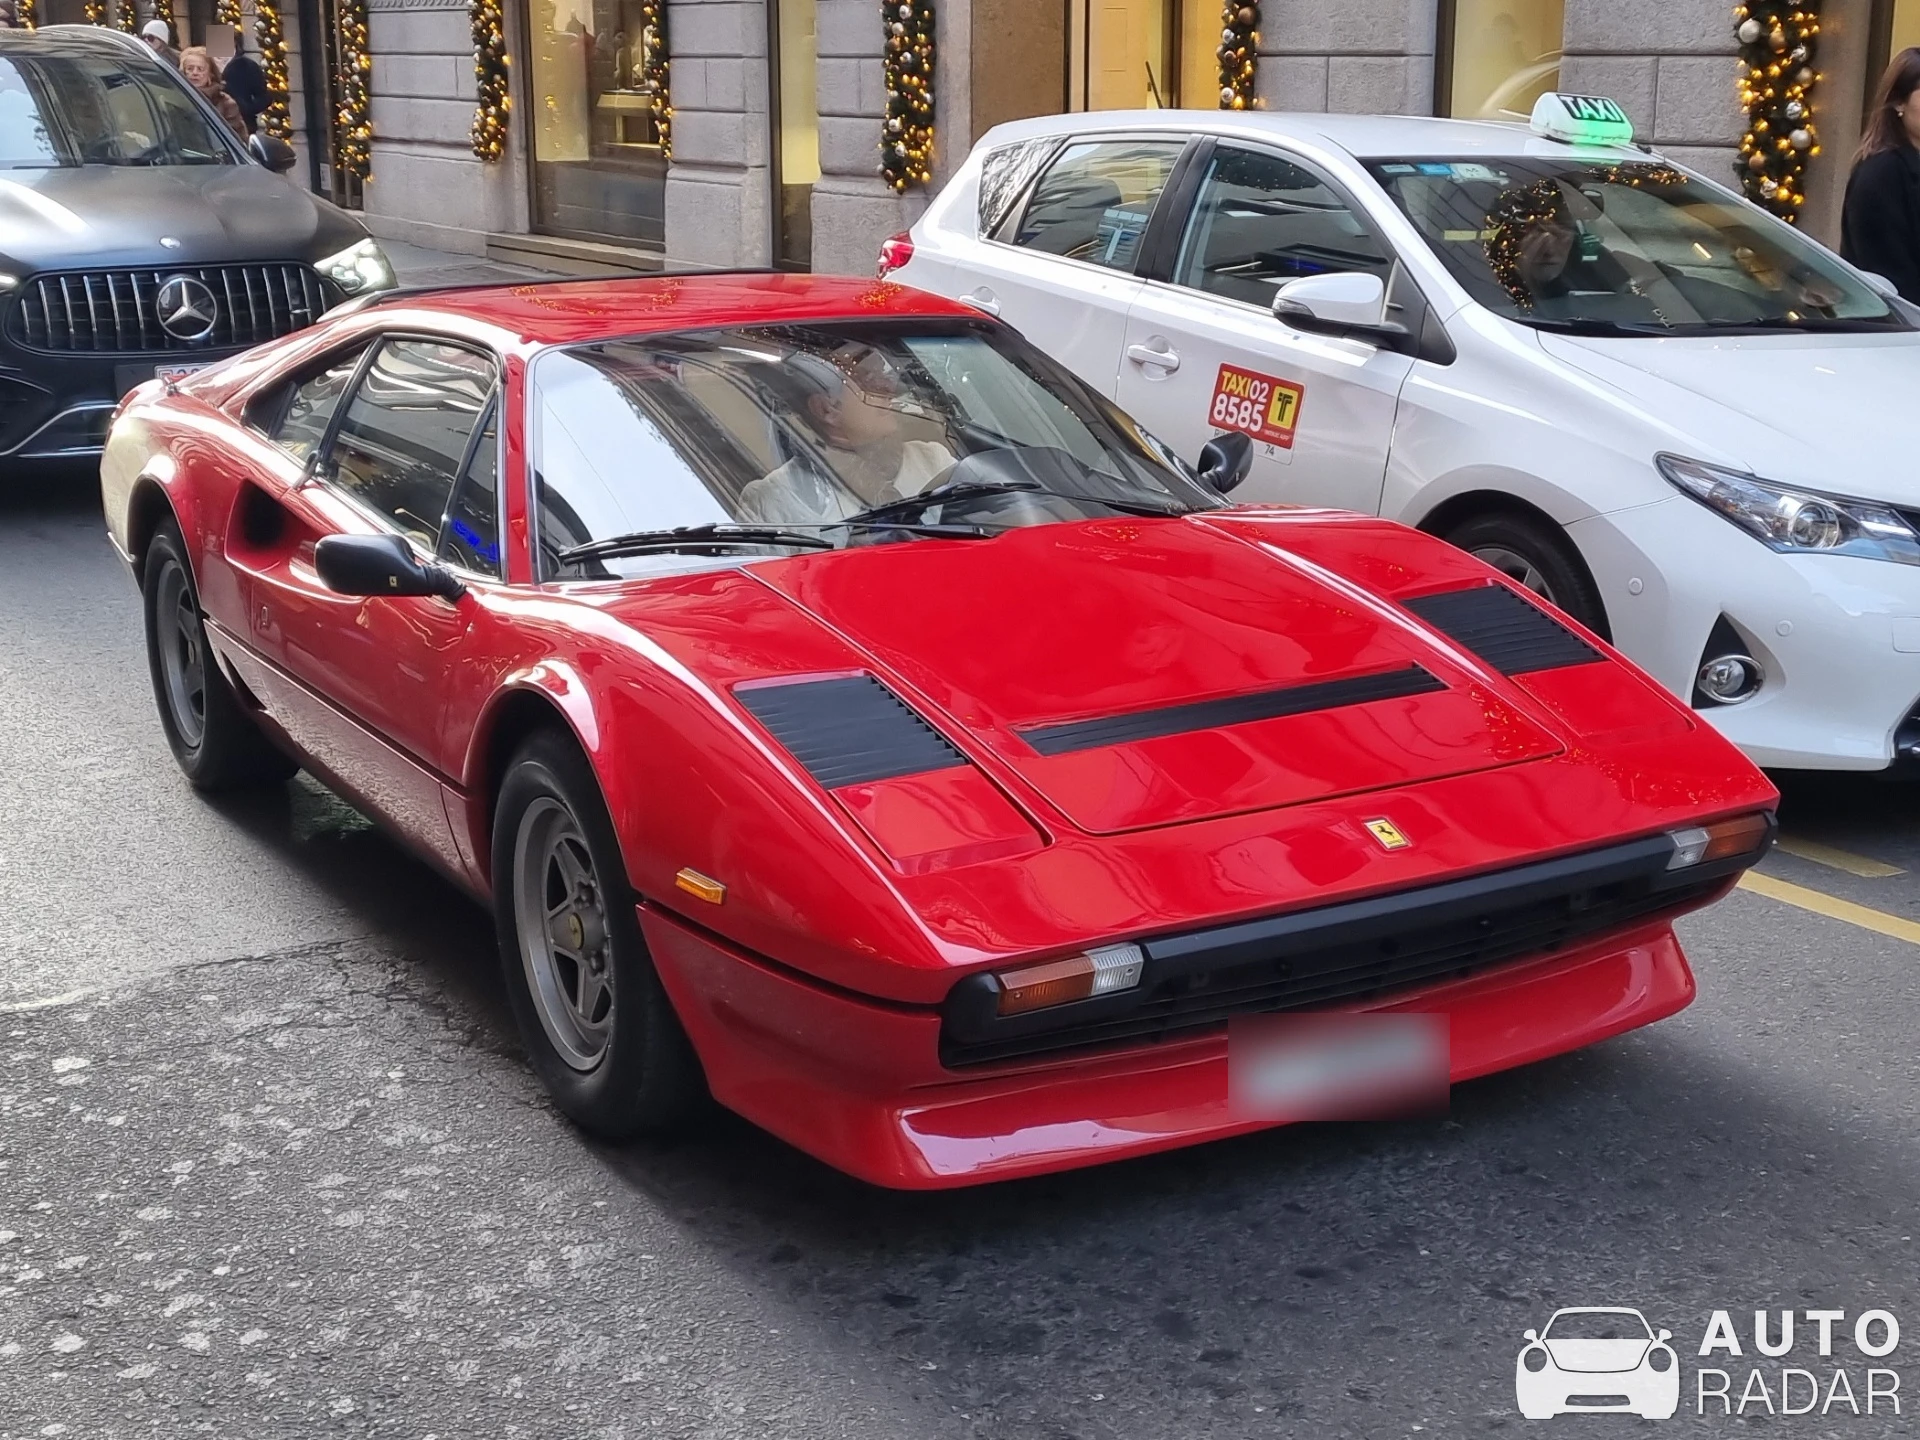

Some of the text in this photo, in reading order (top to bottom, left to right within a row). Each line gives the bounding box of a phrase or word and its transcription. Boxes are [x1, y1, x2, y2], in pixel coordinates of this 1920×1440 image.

[1560, 95, 1622, 121] TAXI
[1213, 393, 1265, 432] 8585
[1265, 444, 1275, 456] 74
